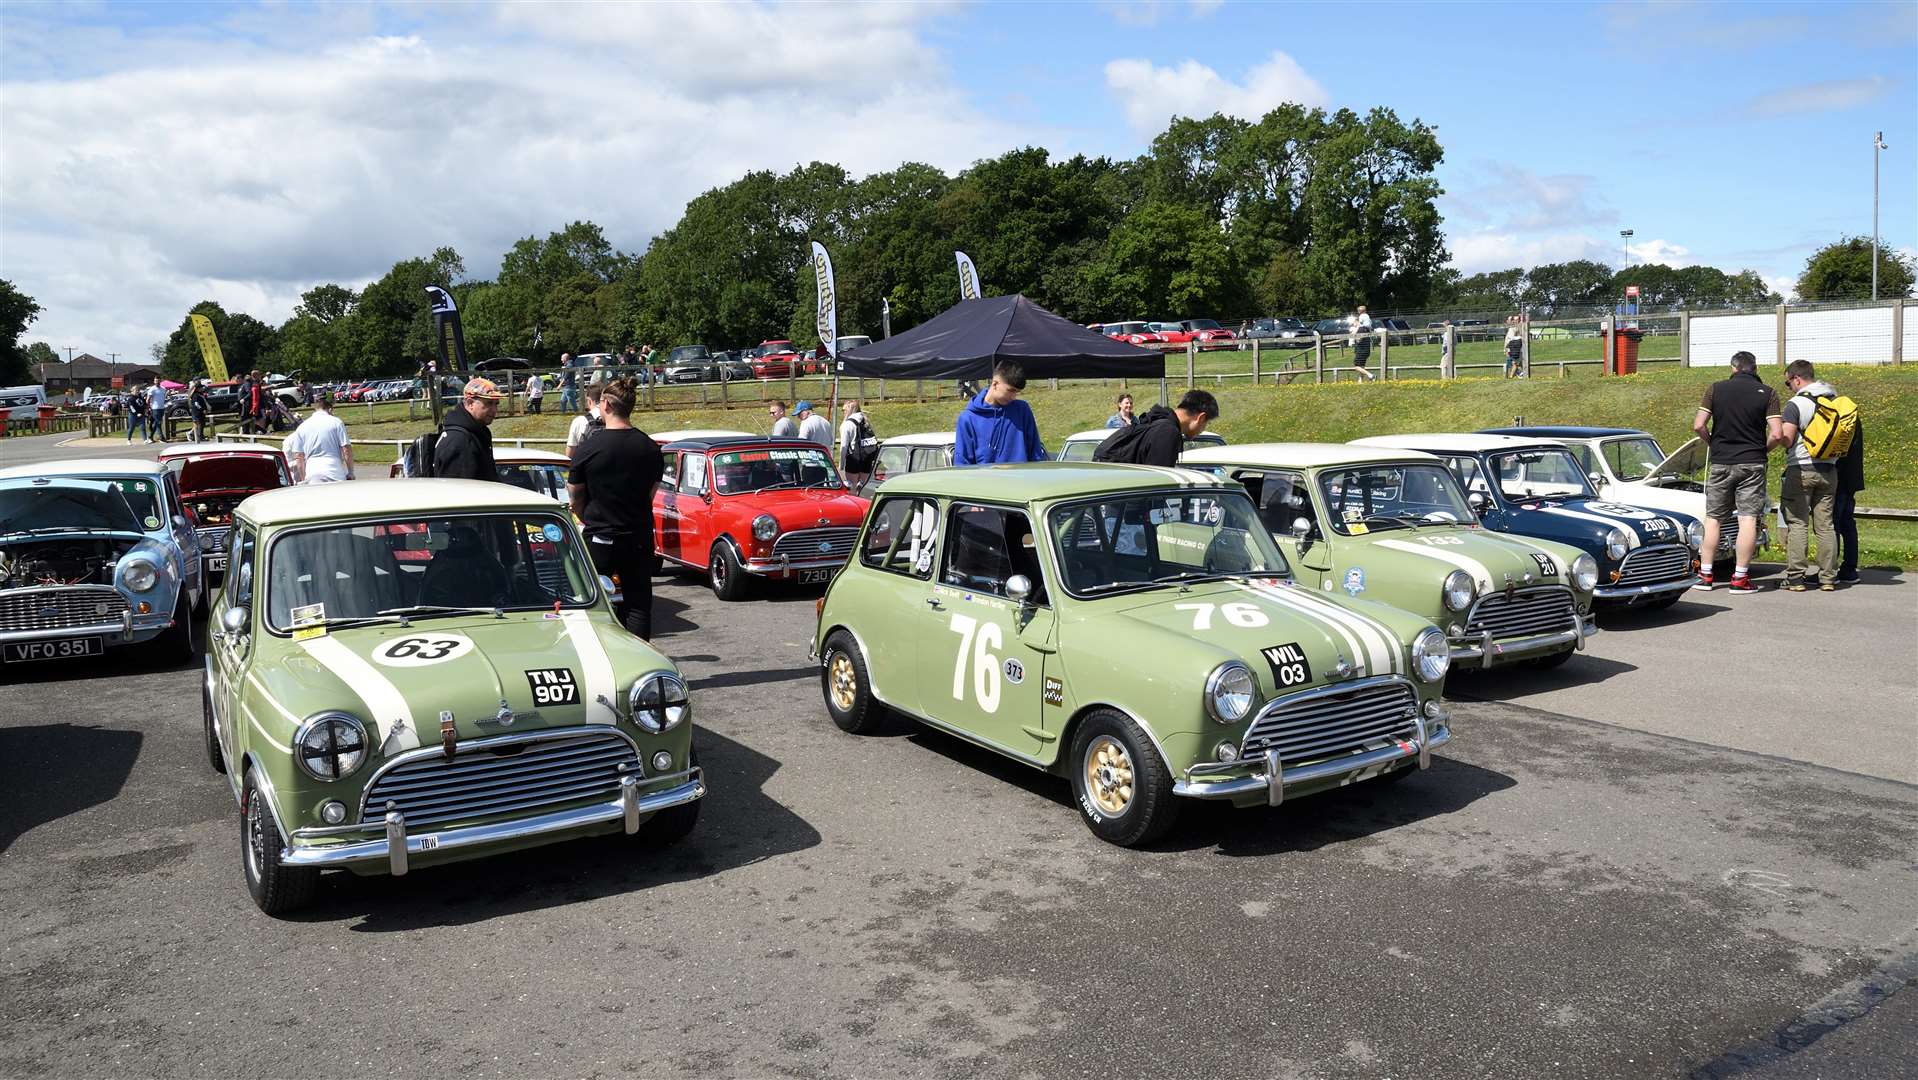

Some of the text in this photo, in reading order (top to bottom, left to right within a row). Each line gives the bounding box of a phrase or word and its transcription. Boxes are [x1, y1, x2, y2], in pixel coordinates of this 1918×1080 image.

[770, 451, 798, 460] Classic
[1416, 536, 1465, 545] 133
[805, 570, 827, 583] 730
[1174, 602, 1269, 630] 76
[17, 643, 55, 660] VFO
[385, 637, 460, 660] 63
[1265, 645, 1304, 665] WIL
[950, 613, 1002, 714] 76
[1006, 662, 1024, 679] 373
[530, 670, 571, 686] TNJ
[1280, 664, 1305, 685] 03
[536, 685, 575, 703] 907
[421, 838, 436, 849] TOW
